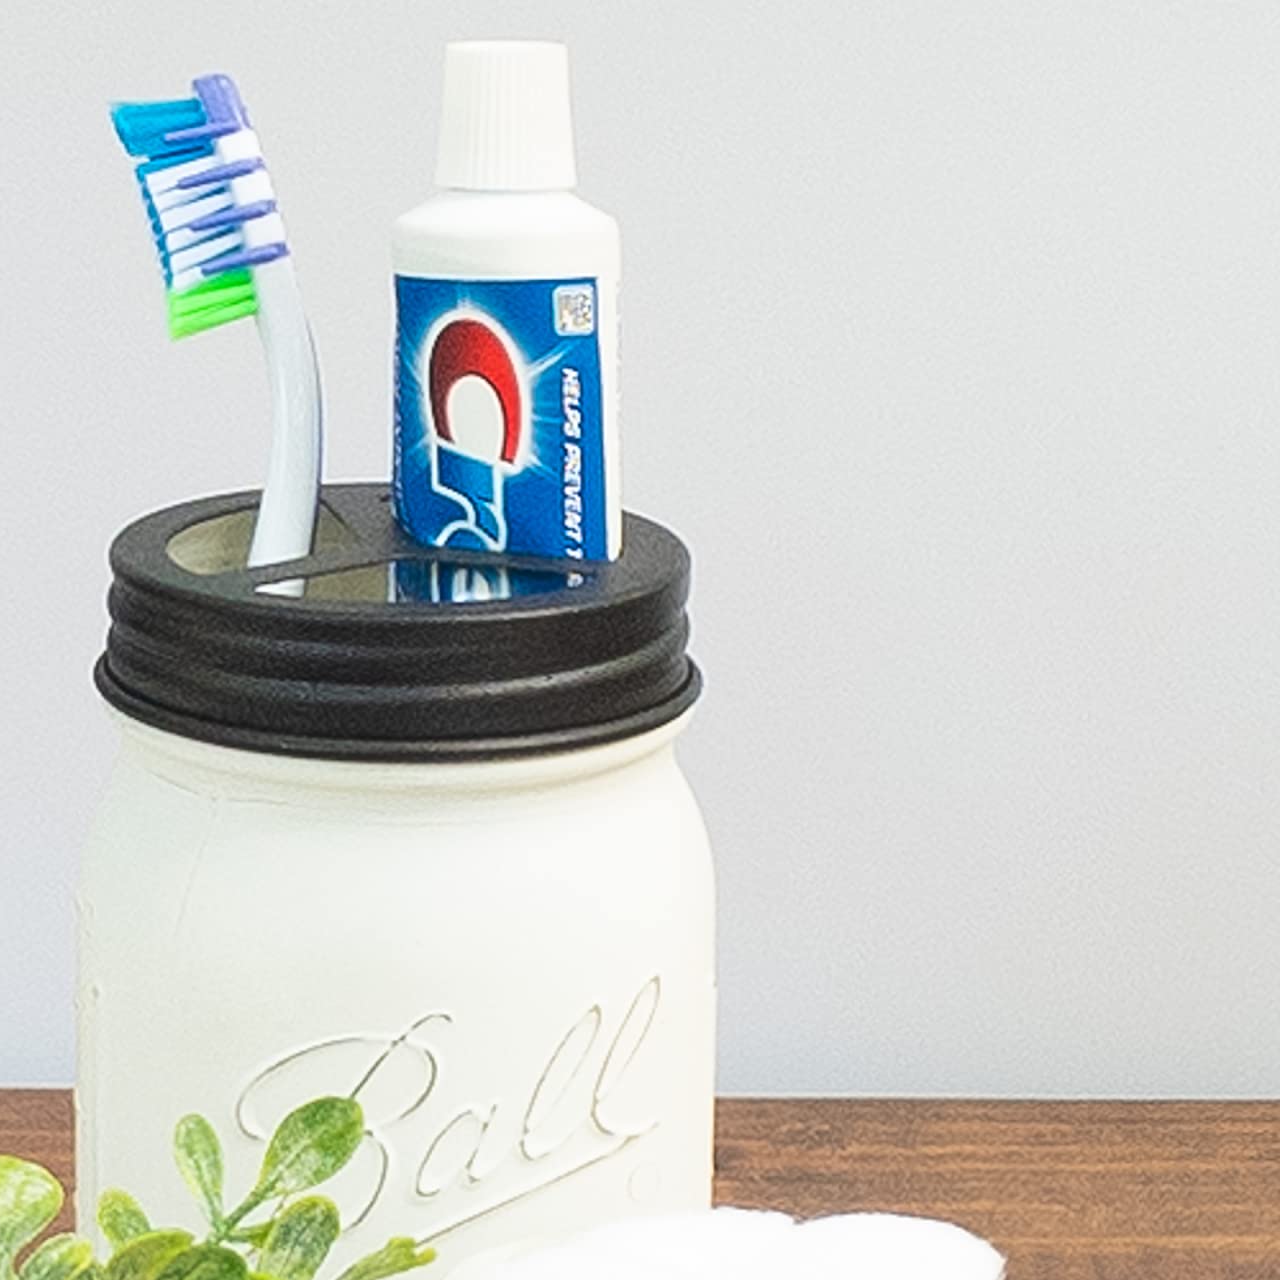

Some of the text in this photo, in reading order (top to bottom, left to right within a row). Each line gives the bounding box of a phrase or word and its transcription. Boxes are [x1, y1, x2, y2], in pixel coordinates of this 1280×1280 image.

[562, 368, 581, 439] HELPS
[564, 443, 582, 544] PREVENT
[235, 974, 661, 1242] Ball
